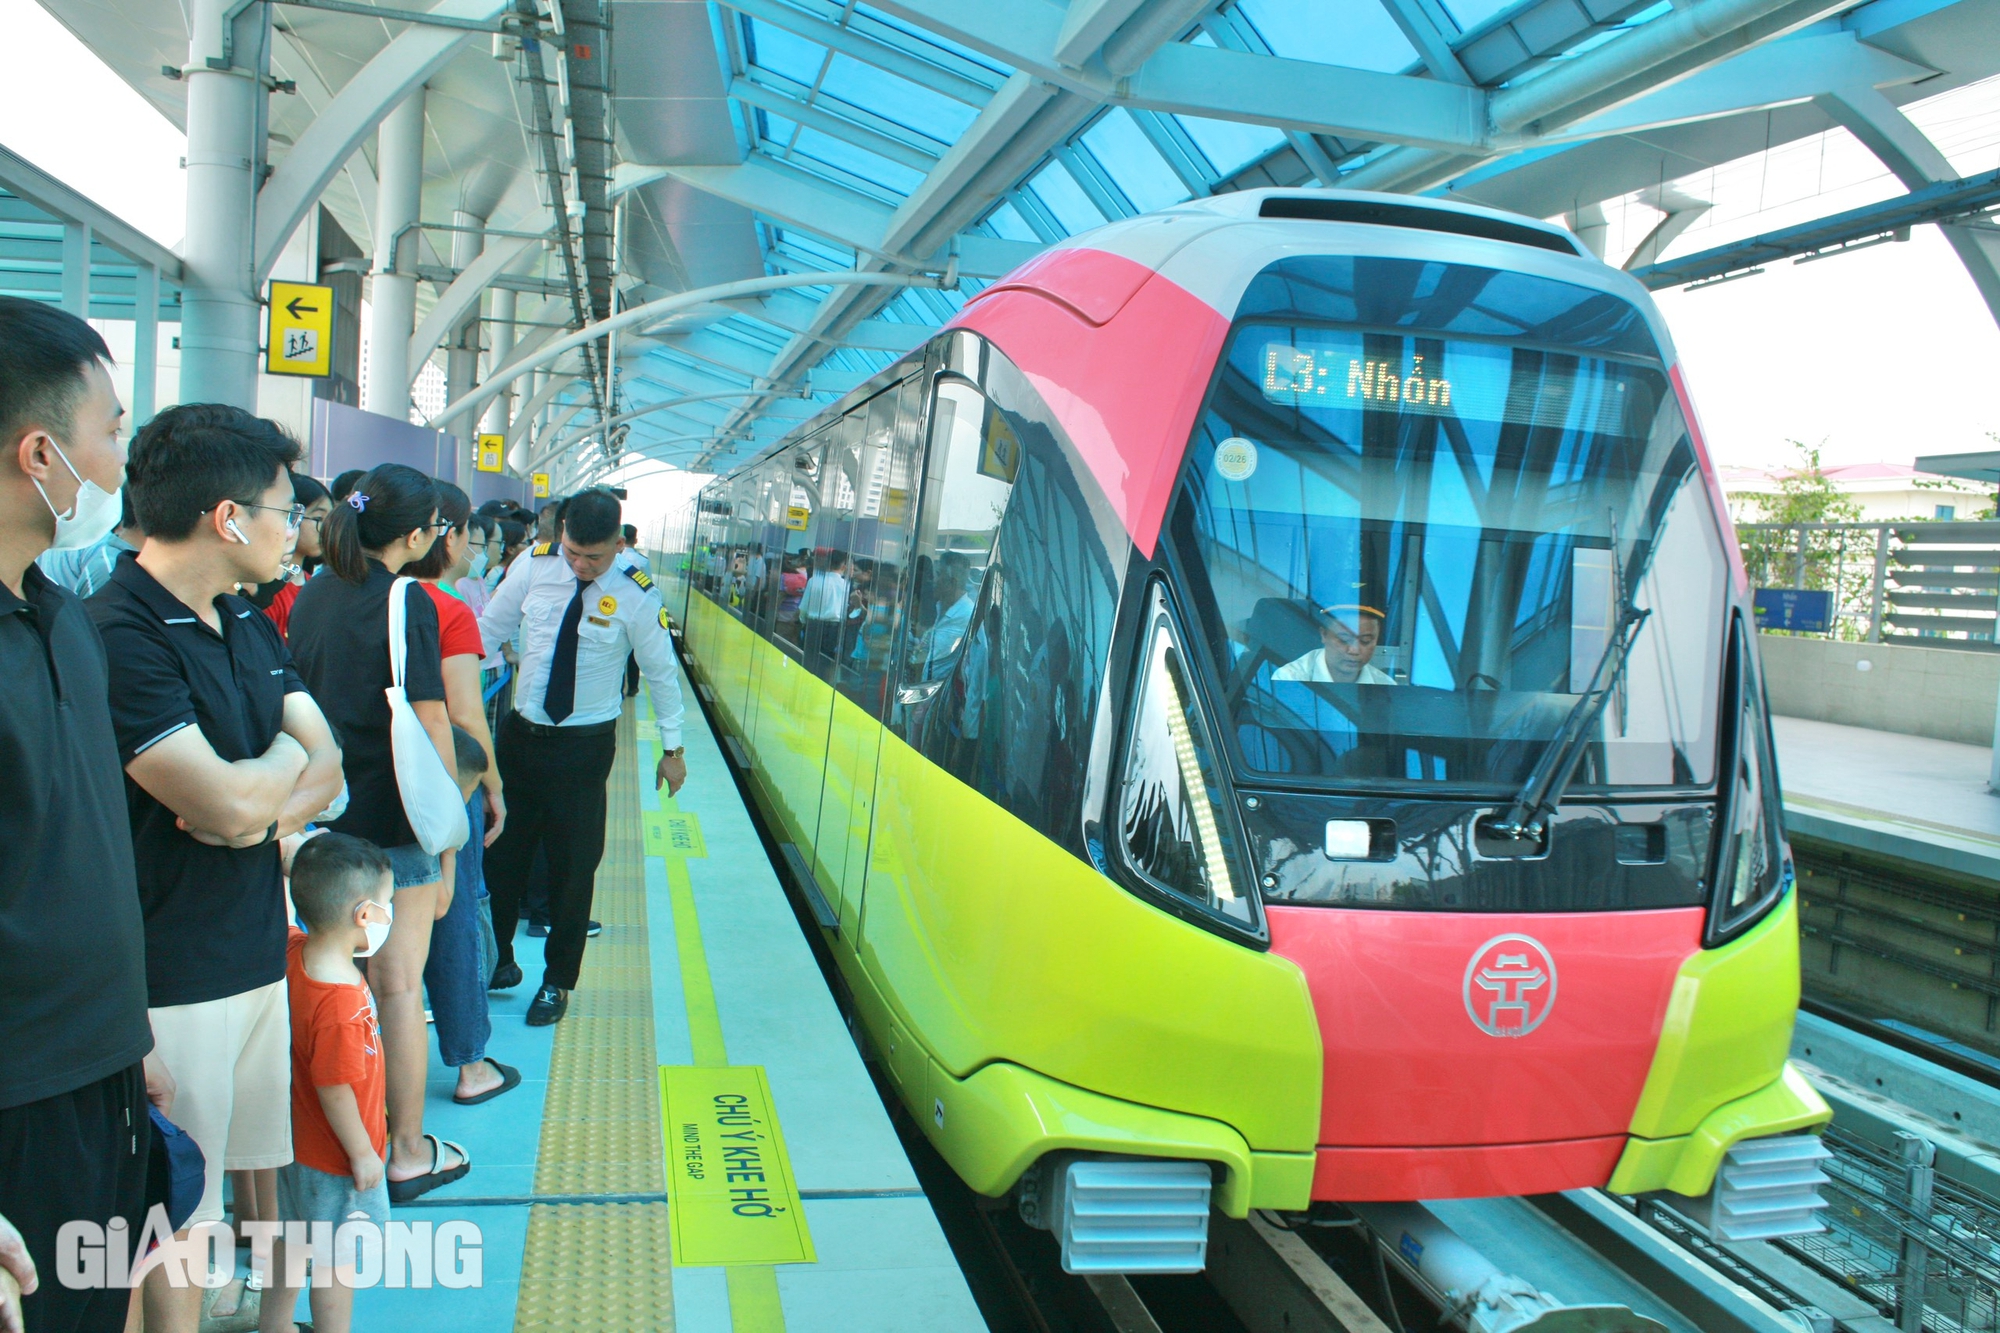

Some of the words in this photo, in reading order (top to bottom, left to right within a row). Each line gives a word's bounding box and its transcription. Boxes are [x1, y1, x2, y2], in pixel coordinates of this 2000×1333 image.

[1266, 351, 1328, 394] L3:
[1347, 353, 1451, 407] Nhổn
[1223, 454, 1247, 464] 02/26
[713, 1094, 762, 1126] CHÚ
[682, 1123, 700, 1143] MIND
[720, 1130, 765, 1141] Ý
[685, 1144, 703, 1160] THE
[686, 1161, 705, 1180] GAP
[722, 1146, 765, 1183] KHE
[729, 1188, 786, 1218] HỞ
